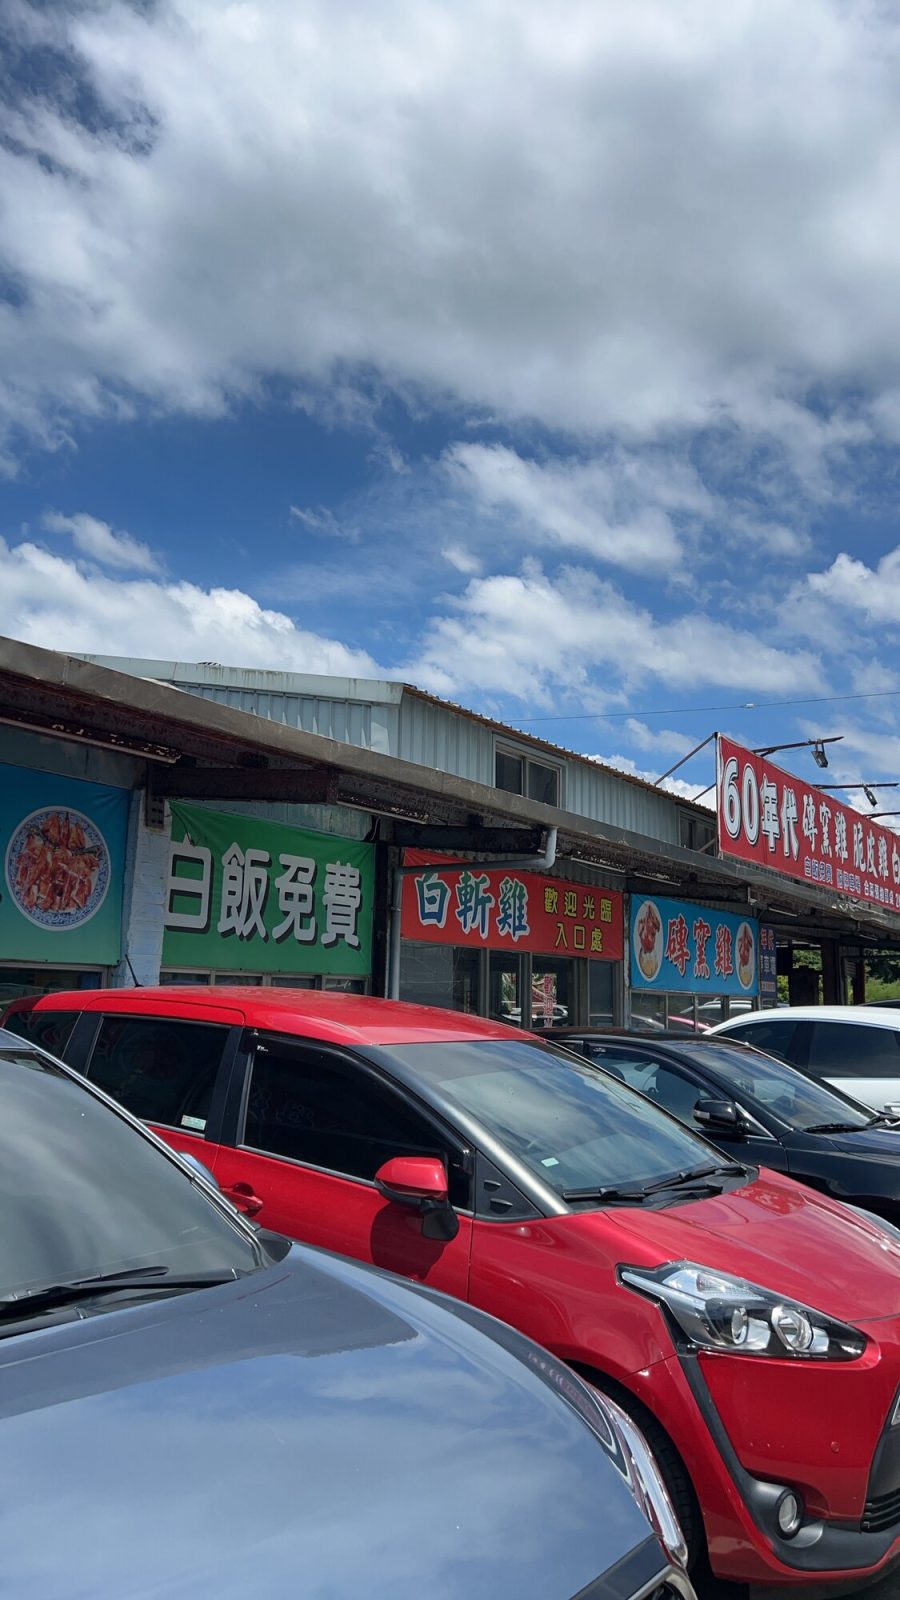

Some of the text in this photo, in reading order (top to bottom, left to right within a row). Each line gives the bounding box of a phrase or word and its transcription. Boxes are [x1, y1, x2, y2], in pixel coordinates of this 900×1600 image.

[723, 756, 799, 861] 60年代
[164, 833, 361, 948] 白飯免費
[415, 863, 530, 942] 白斬雞
[544, 887, 612, 923] 歡迎光臨
[555, 923, 603, 952] 入口處
[665, 913, 734, 980] 磚窯雞
